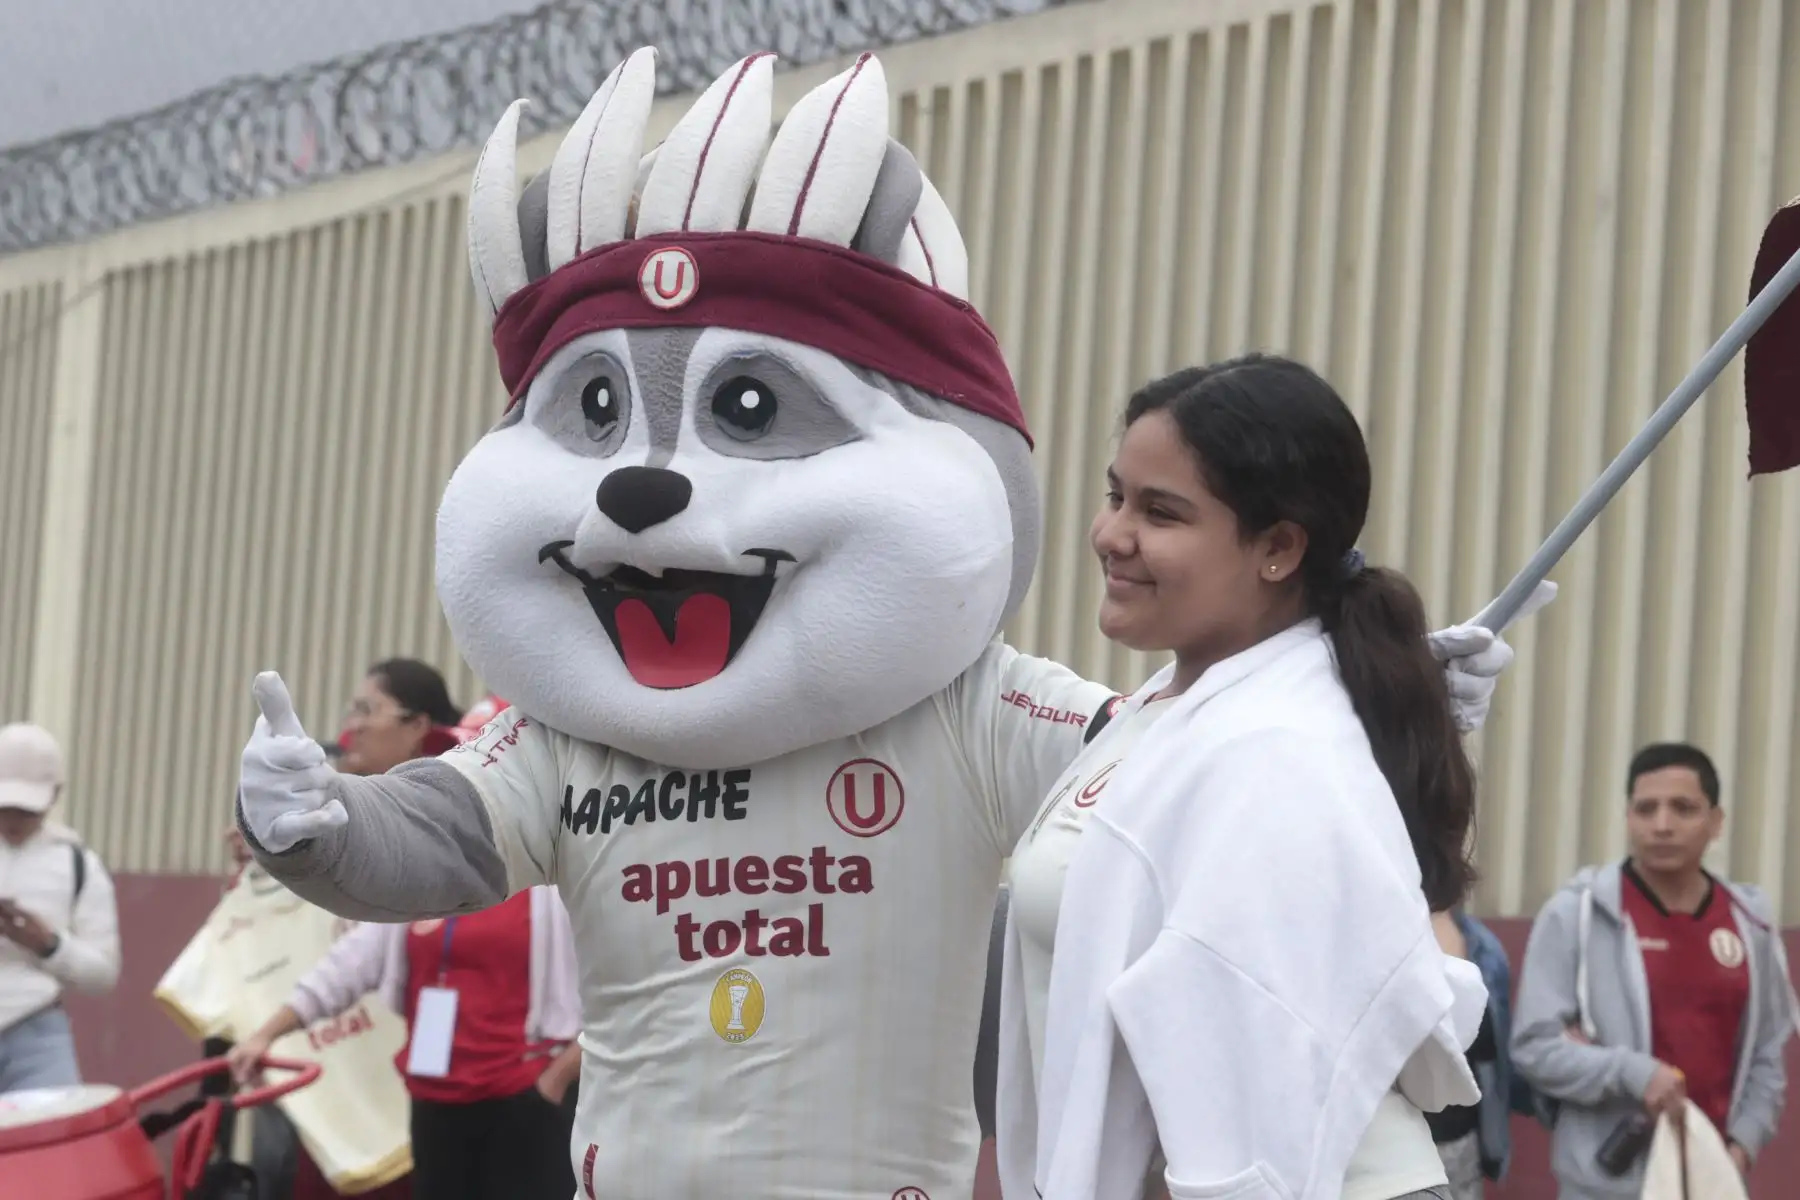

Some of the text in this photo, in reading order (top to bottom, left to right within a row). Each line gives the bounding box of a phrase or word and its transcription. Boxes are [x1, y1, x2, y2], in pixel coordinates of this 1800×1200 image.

[653, 260, 685, 299] U
[1001, 689, 1088, 728] JETOUR
[844, 772, 886, 829] U
[621, 845, 875, 916] apuesta
[674, 902, 831, 963] total
